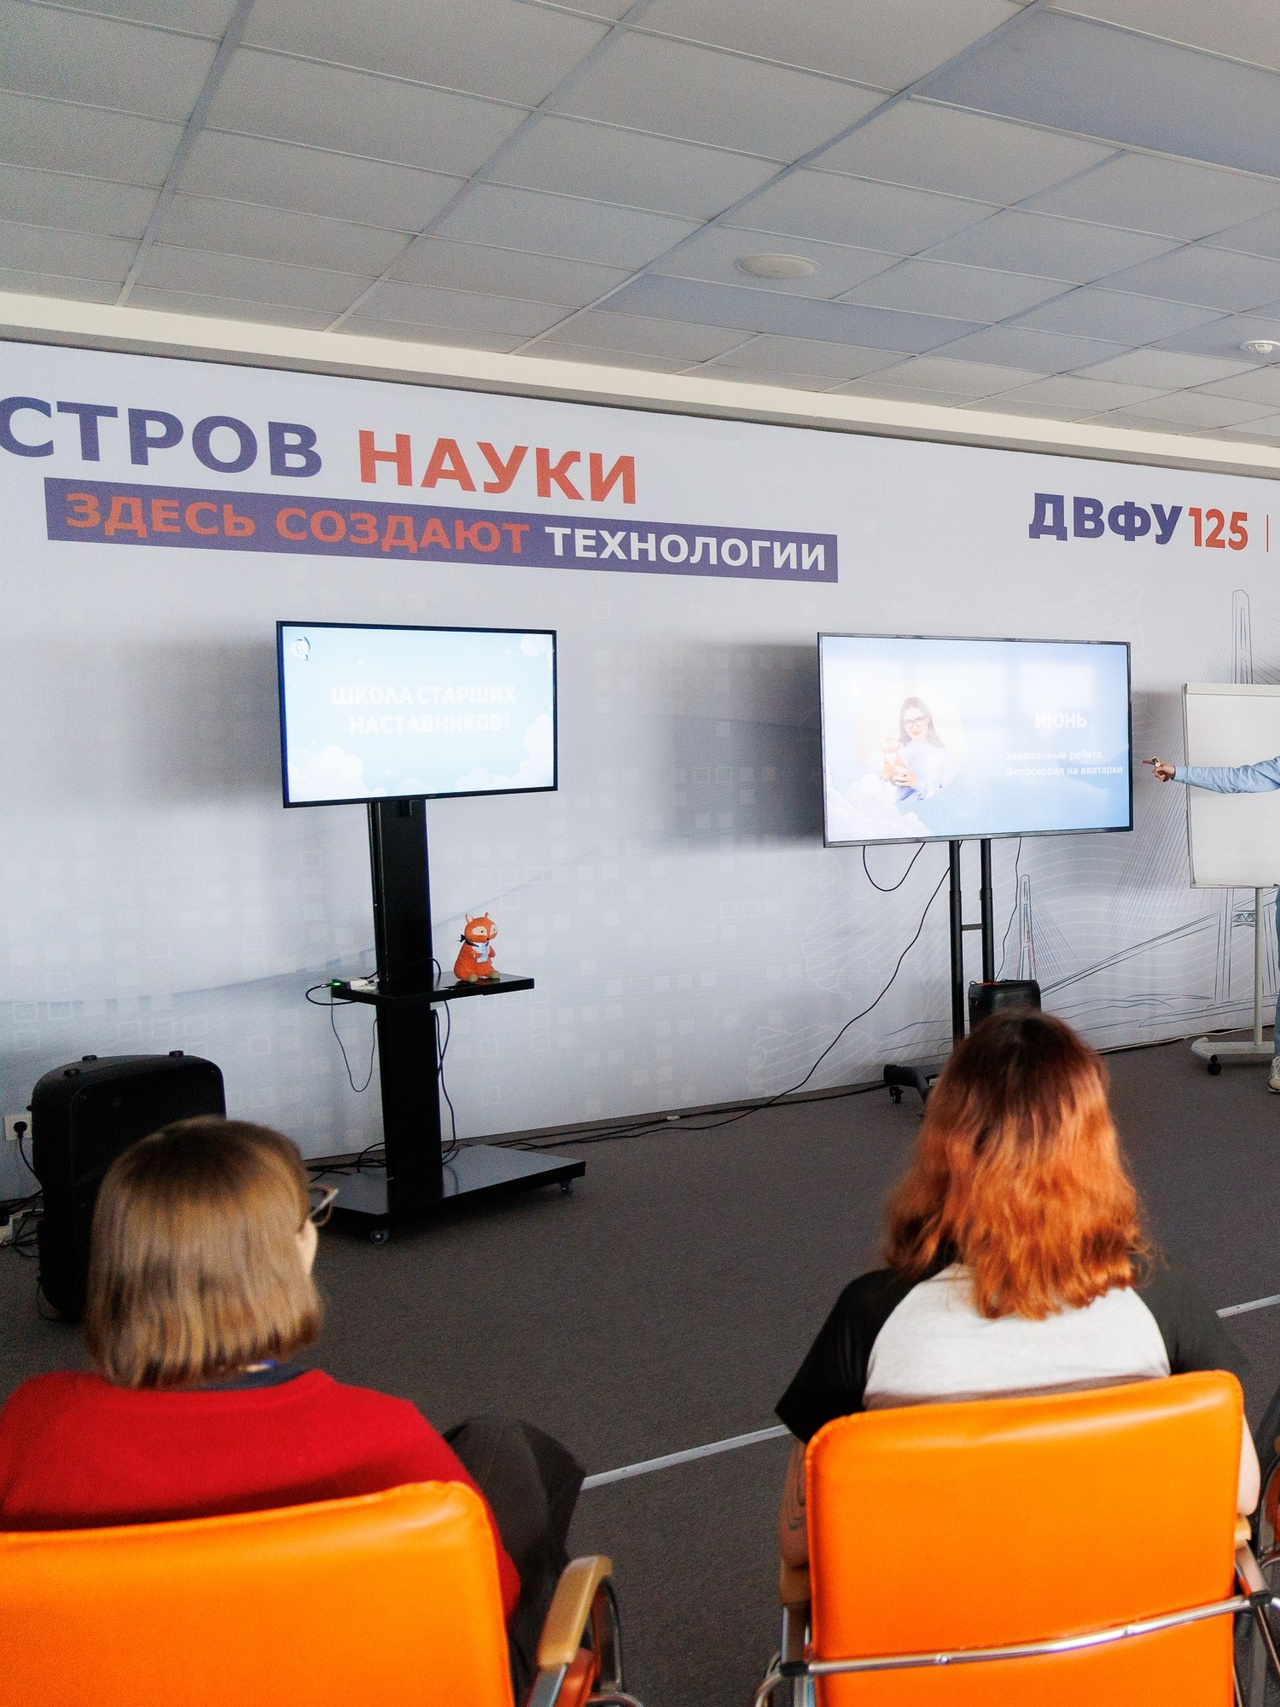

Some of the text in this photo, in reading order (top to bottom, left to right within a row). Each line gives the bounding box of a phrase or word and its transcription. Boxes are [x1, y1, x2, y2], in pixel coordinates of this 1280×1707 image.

[0, 396, 638, 505] СТРОВ НАУКИ
[65, 492, 827, 572] ЗДЕСЬ СОЗДАЮТ ТЕХНОЛОГИИ
[330, 685, 517, 706] ШКОЛА СТАРШИХ
[1034, 711, 1088, 729] ИЮНЬ
[1069, 749, 1102, 761] ребята
[1004, 766, 1124, 776] Фотосессия на аватарки
